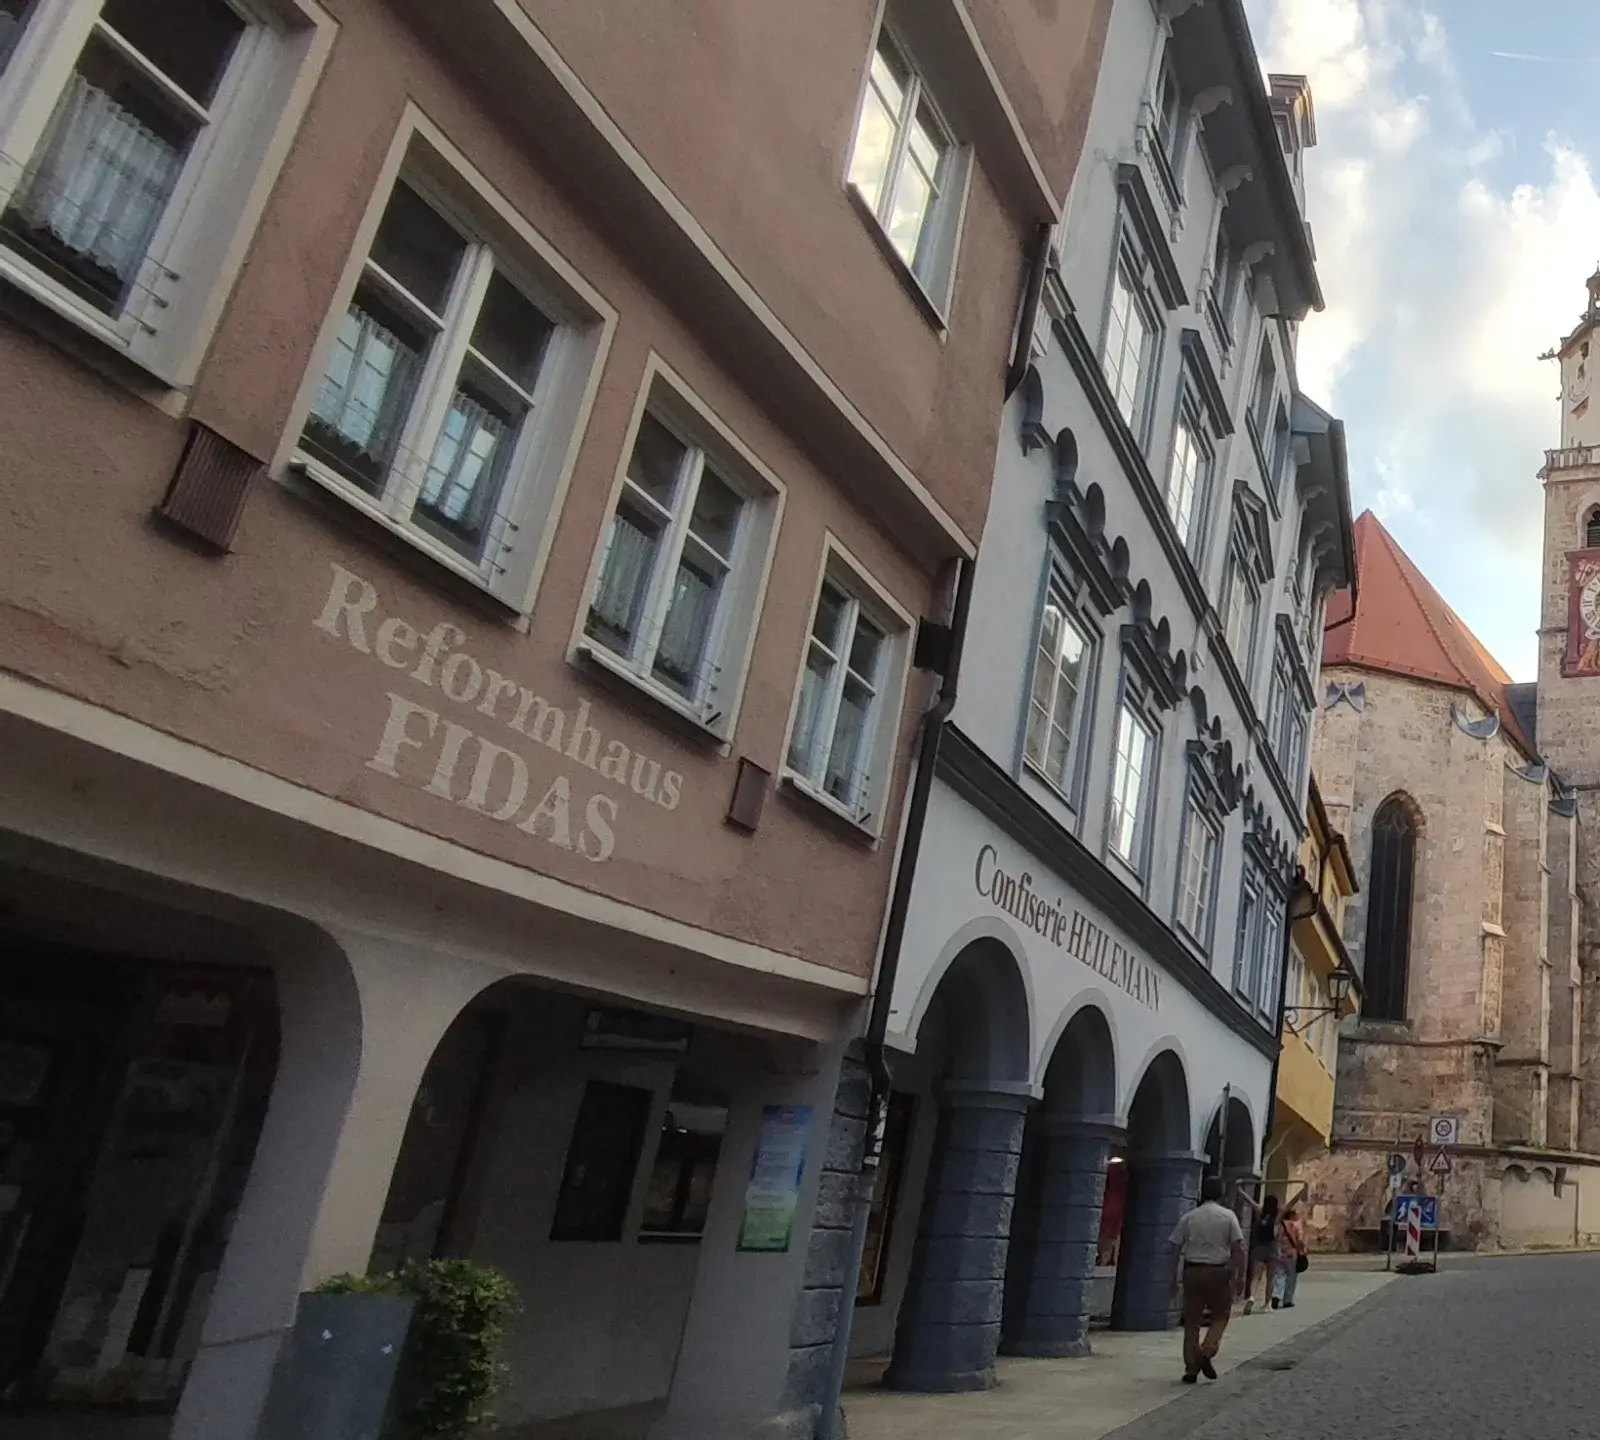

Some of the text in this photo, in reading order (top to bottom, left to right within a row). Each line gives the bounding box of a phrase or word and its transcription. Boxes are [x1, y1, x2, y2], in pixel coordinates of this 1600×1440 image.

[312, 561, 684, 811] Reformhaus
[365, 691, 618, 862] FIDAS
[975, 844, 1162, 1012] Confiserie HEILEMANN
